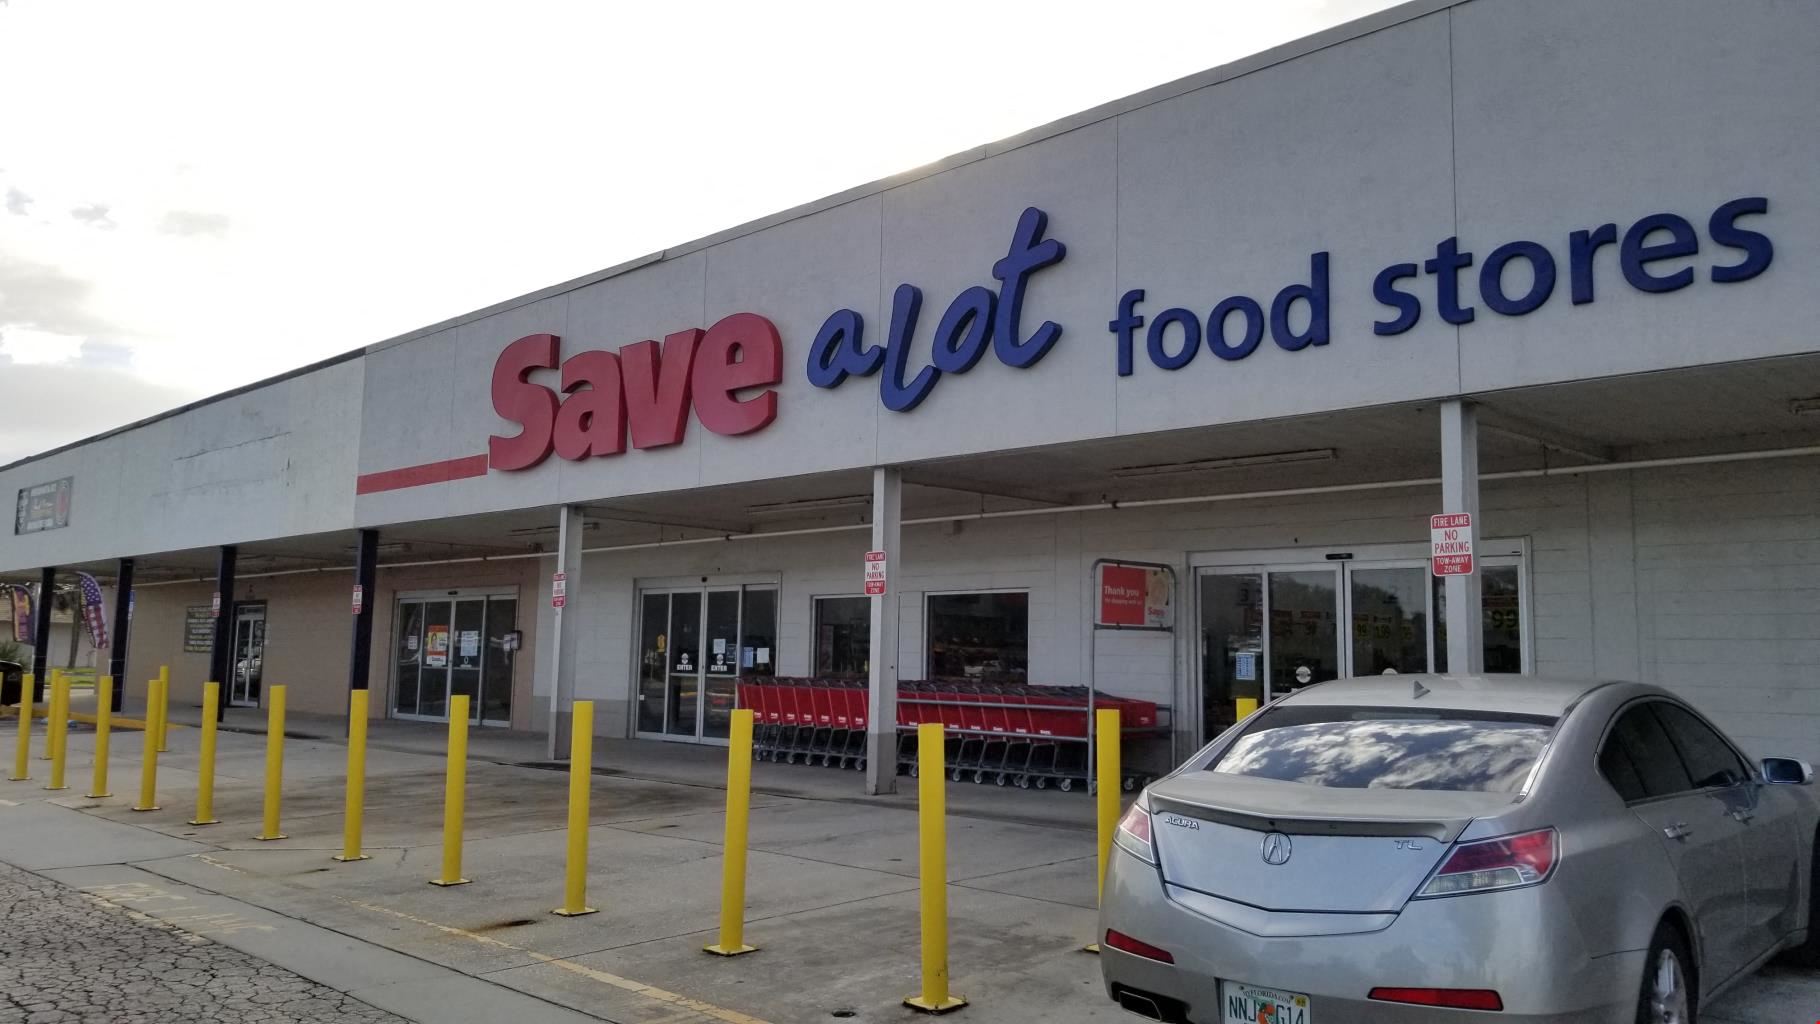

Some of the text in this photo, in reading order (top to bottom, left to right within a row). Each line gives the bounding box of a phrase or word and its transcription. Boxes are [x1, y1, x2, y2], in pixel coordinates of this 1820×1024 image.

[489, 312, 783, 471] Save
[1109, 251, 1330, 377] food
[1373, 196, 1774, 337] stores
[1433, 515, 1469, 528] FIRE LANE
[1444, 529, 1458, 541] NO
[1434, 541, 1470, 555] PARKING
[872, 563, 880, 571] NO
[1436, 556, 1469, 566] TOW-AWAY
[1444, 564, 1462, 573] ZONE
[1104, 585, 1140, 599] Thank you
[1164, 816, 1200, 831] ACURA
[1393, 839, 1424, 851] TL
[1228, 995, 1305, 1024] NNJ G14
